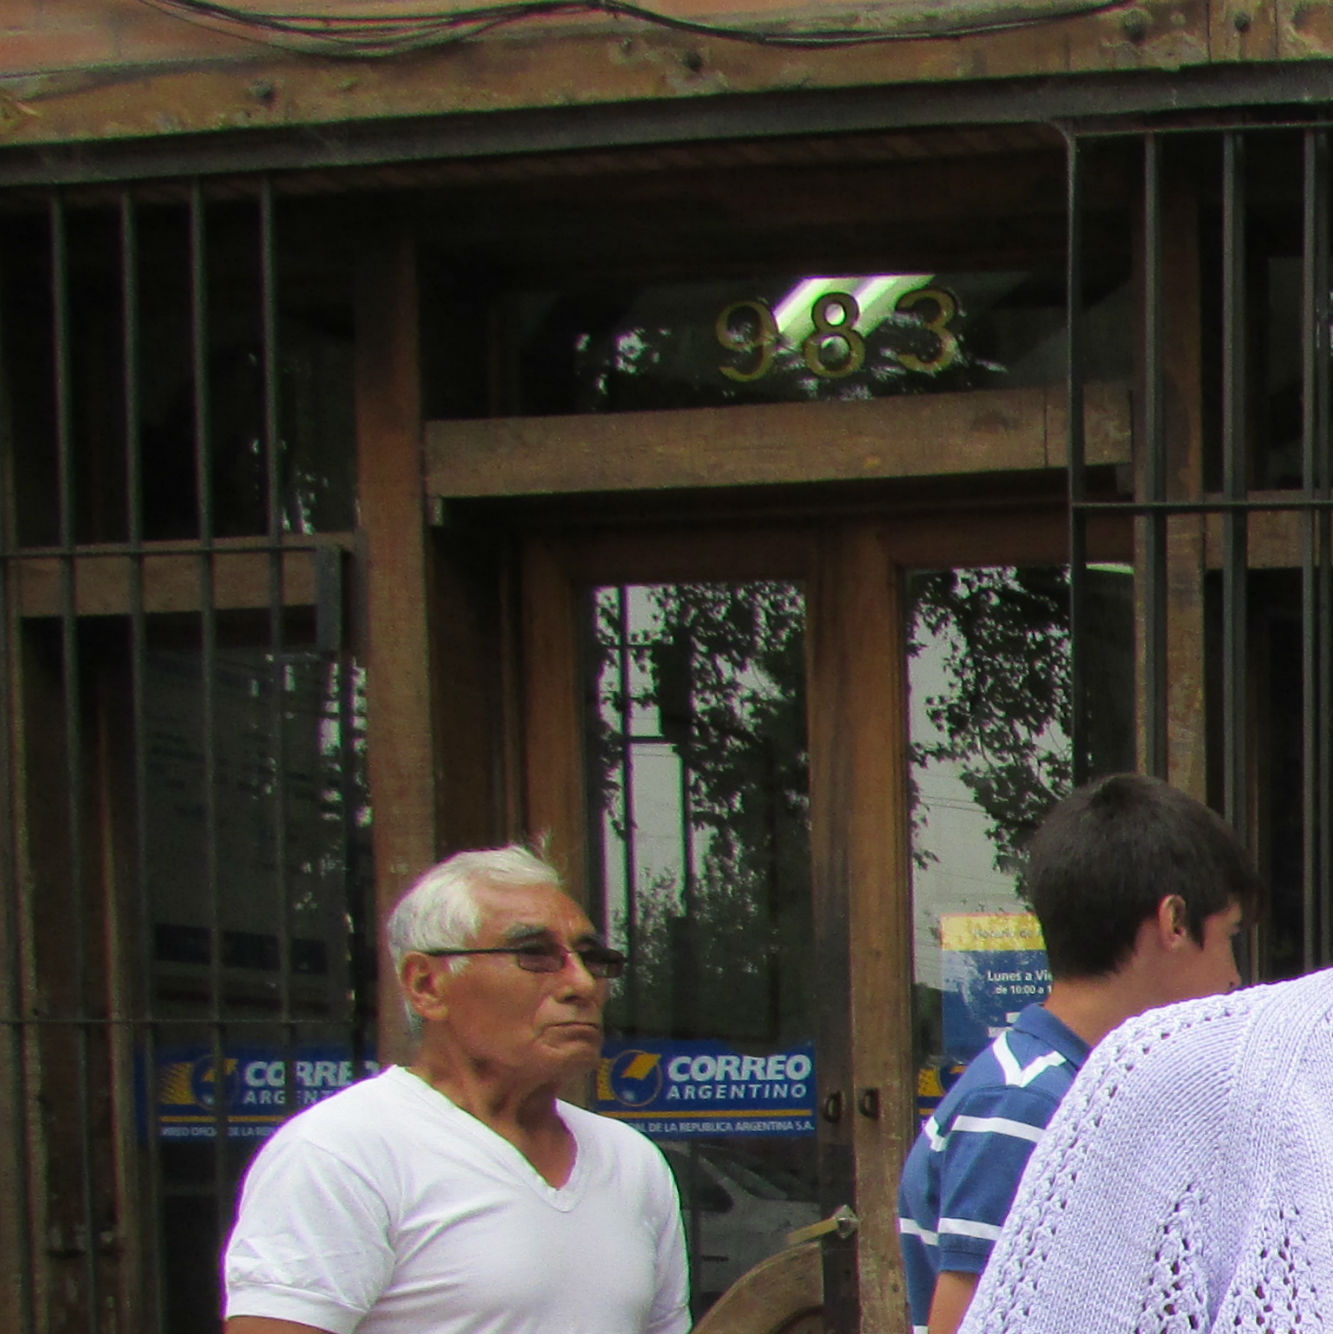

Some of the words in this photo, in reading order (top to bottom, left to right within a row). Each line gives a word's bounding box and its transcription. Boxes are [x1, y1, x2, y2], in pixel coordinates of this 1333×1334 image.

[715, 286, 958, 382] 983
[987, 970, 1022, 982] Lunes
[1025, 973, 1033, 982] a
[667, 1054, 813, 1082] CORREO
[666, 1084, 808, 1100] ARGENTINO
